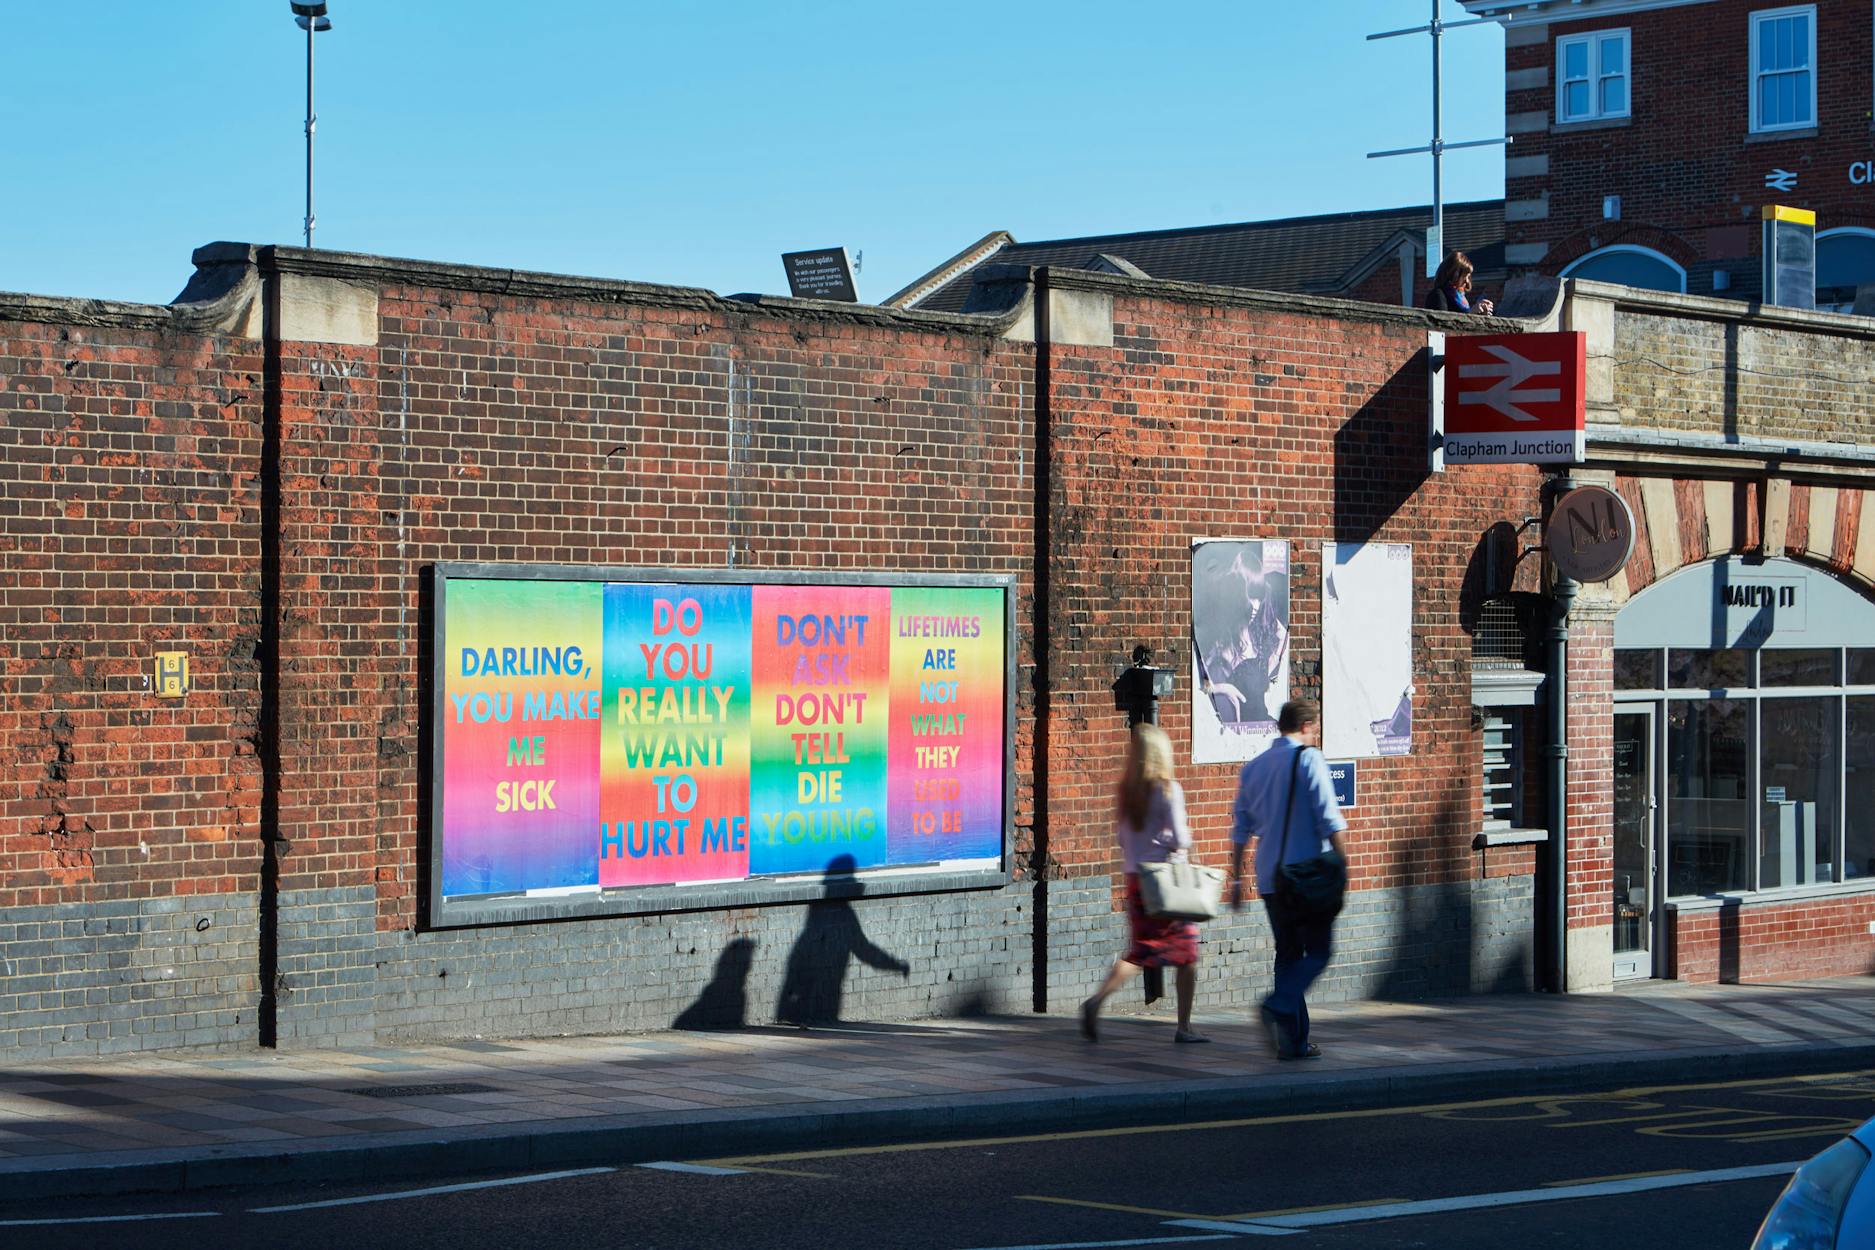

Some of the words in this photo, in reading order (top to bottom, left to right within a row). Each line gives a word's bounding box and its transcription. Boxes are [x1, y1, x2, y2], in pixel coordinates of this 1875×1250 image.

[794, 257, 815, 267] Service
[816, 255, 834, 266] update
[1446, 440, 1507, 459] Clapham
[1511, 439, 1573, 456] Junction
[1780, 585, 1797, 608] IT
[653, 598, 703, 636] DO
[776, 614, 869, 648] DON'T
[899, 615, 980, 638] LIFETIMES
[159, 656, 184, 692] H
[169, 660, 175, 669] 6
[461, 646, 592, 680] DARLING,
[640, 642, 713, 681] YOU
[791, 653, 852, 688] ASK
[923, 648, 956, 670] ARE
[169, 680, 175, 690] 6
[919, 680, 959, 704] NOT
[450, 691, 513, 724] YOU
[522, 690, 600, 722] MAKE
[618, 686, 735, 725] REALLY
[776, 692, 867, 726] DON'T
[911, 713, 967, 736] WHAT
[1239, 724, 1267, 737] Winning
[506, 736, 546, 767] ME
[623, 727, 728, 768] WANT
[791, 731, 850, 765] TELL
[915, 745, 961, 769] THEY
[798, 770, 842, 804] DIE
[914, 778, 961, 802] USED
[1329, 769, 1345, 779] cess
[496, 779, 556, 812] SICK
[652, 774, 698, 813] TO
[600, 819, 690, 860] HURT
[700, 816, 746, 854] ME
[761, 807, 876, 845] YOUNG
[912, 811, 935, 835] TO
[941, 810, 963, 834] BE
